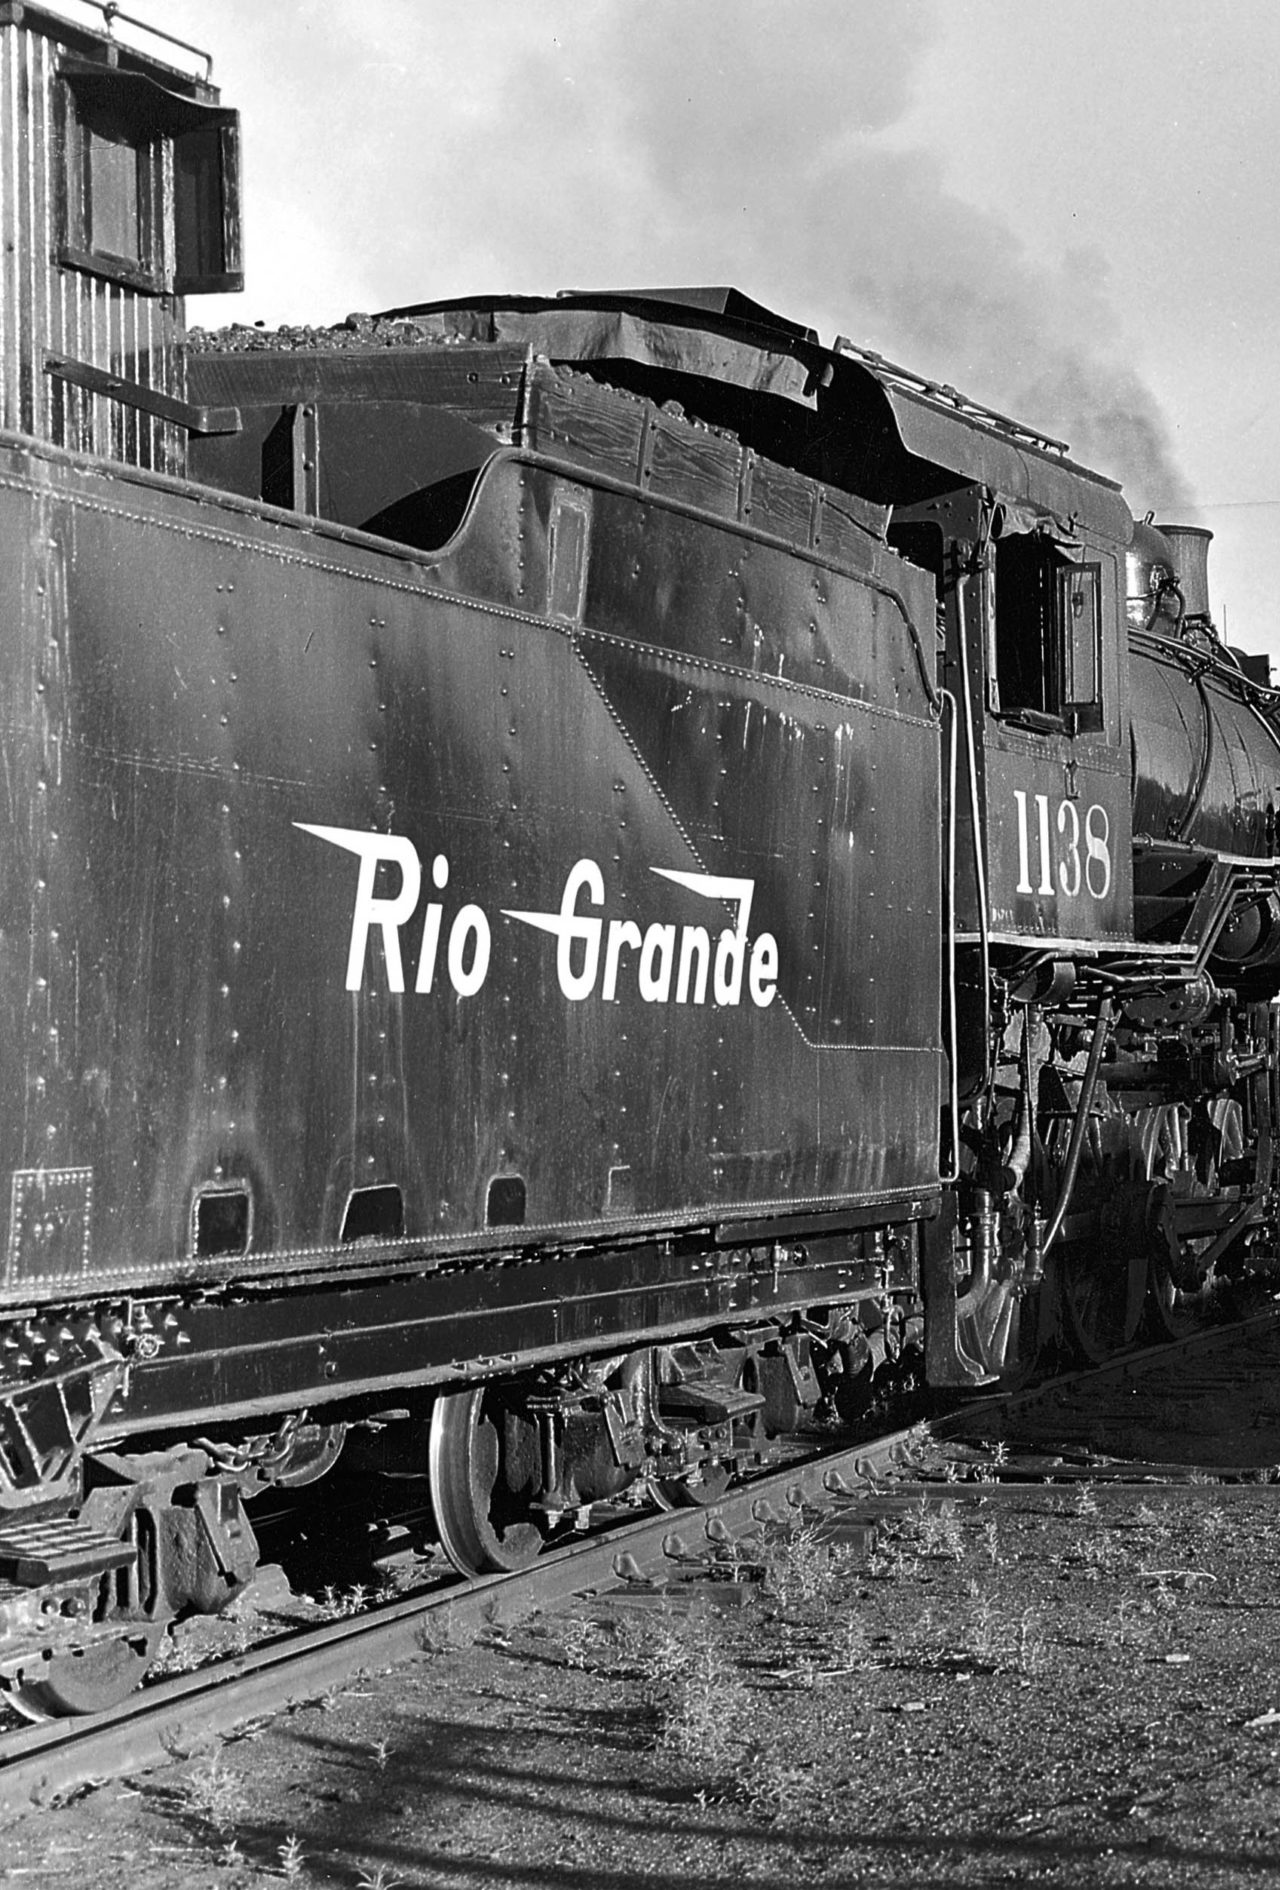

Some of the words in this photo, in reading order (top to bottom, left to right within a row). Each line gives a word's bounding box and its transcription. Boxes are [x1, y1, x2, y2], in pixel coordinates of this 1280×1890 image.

[291, 821, 492, 998] Rio
[500, 858, 779, 1008] Grande
[1013, 790, 1111, 899] 1138
